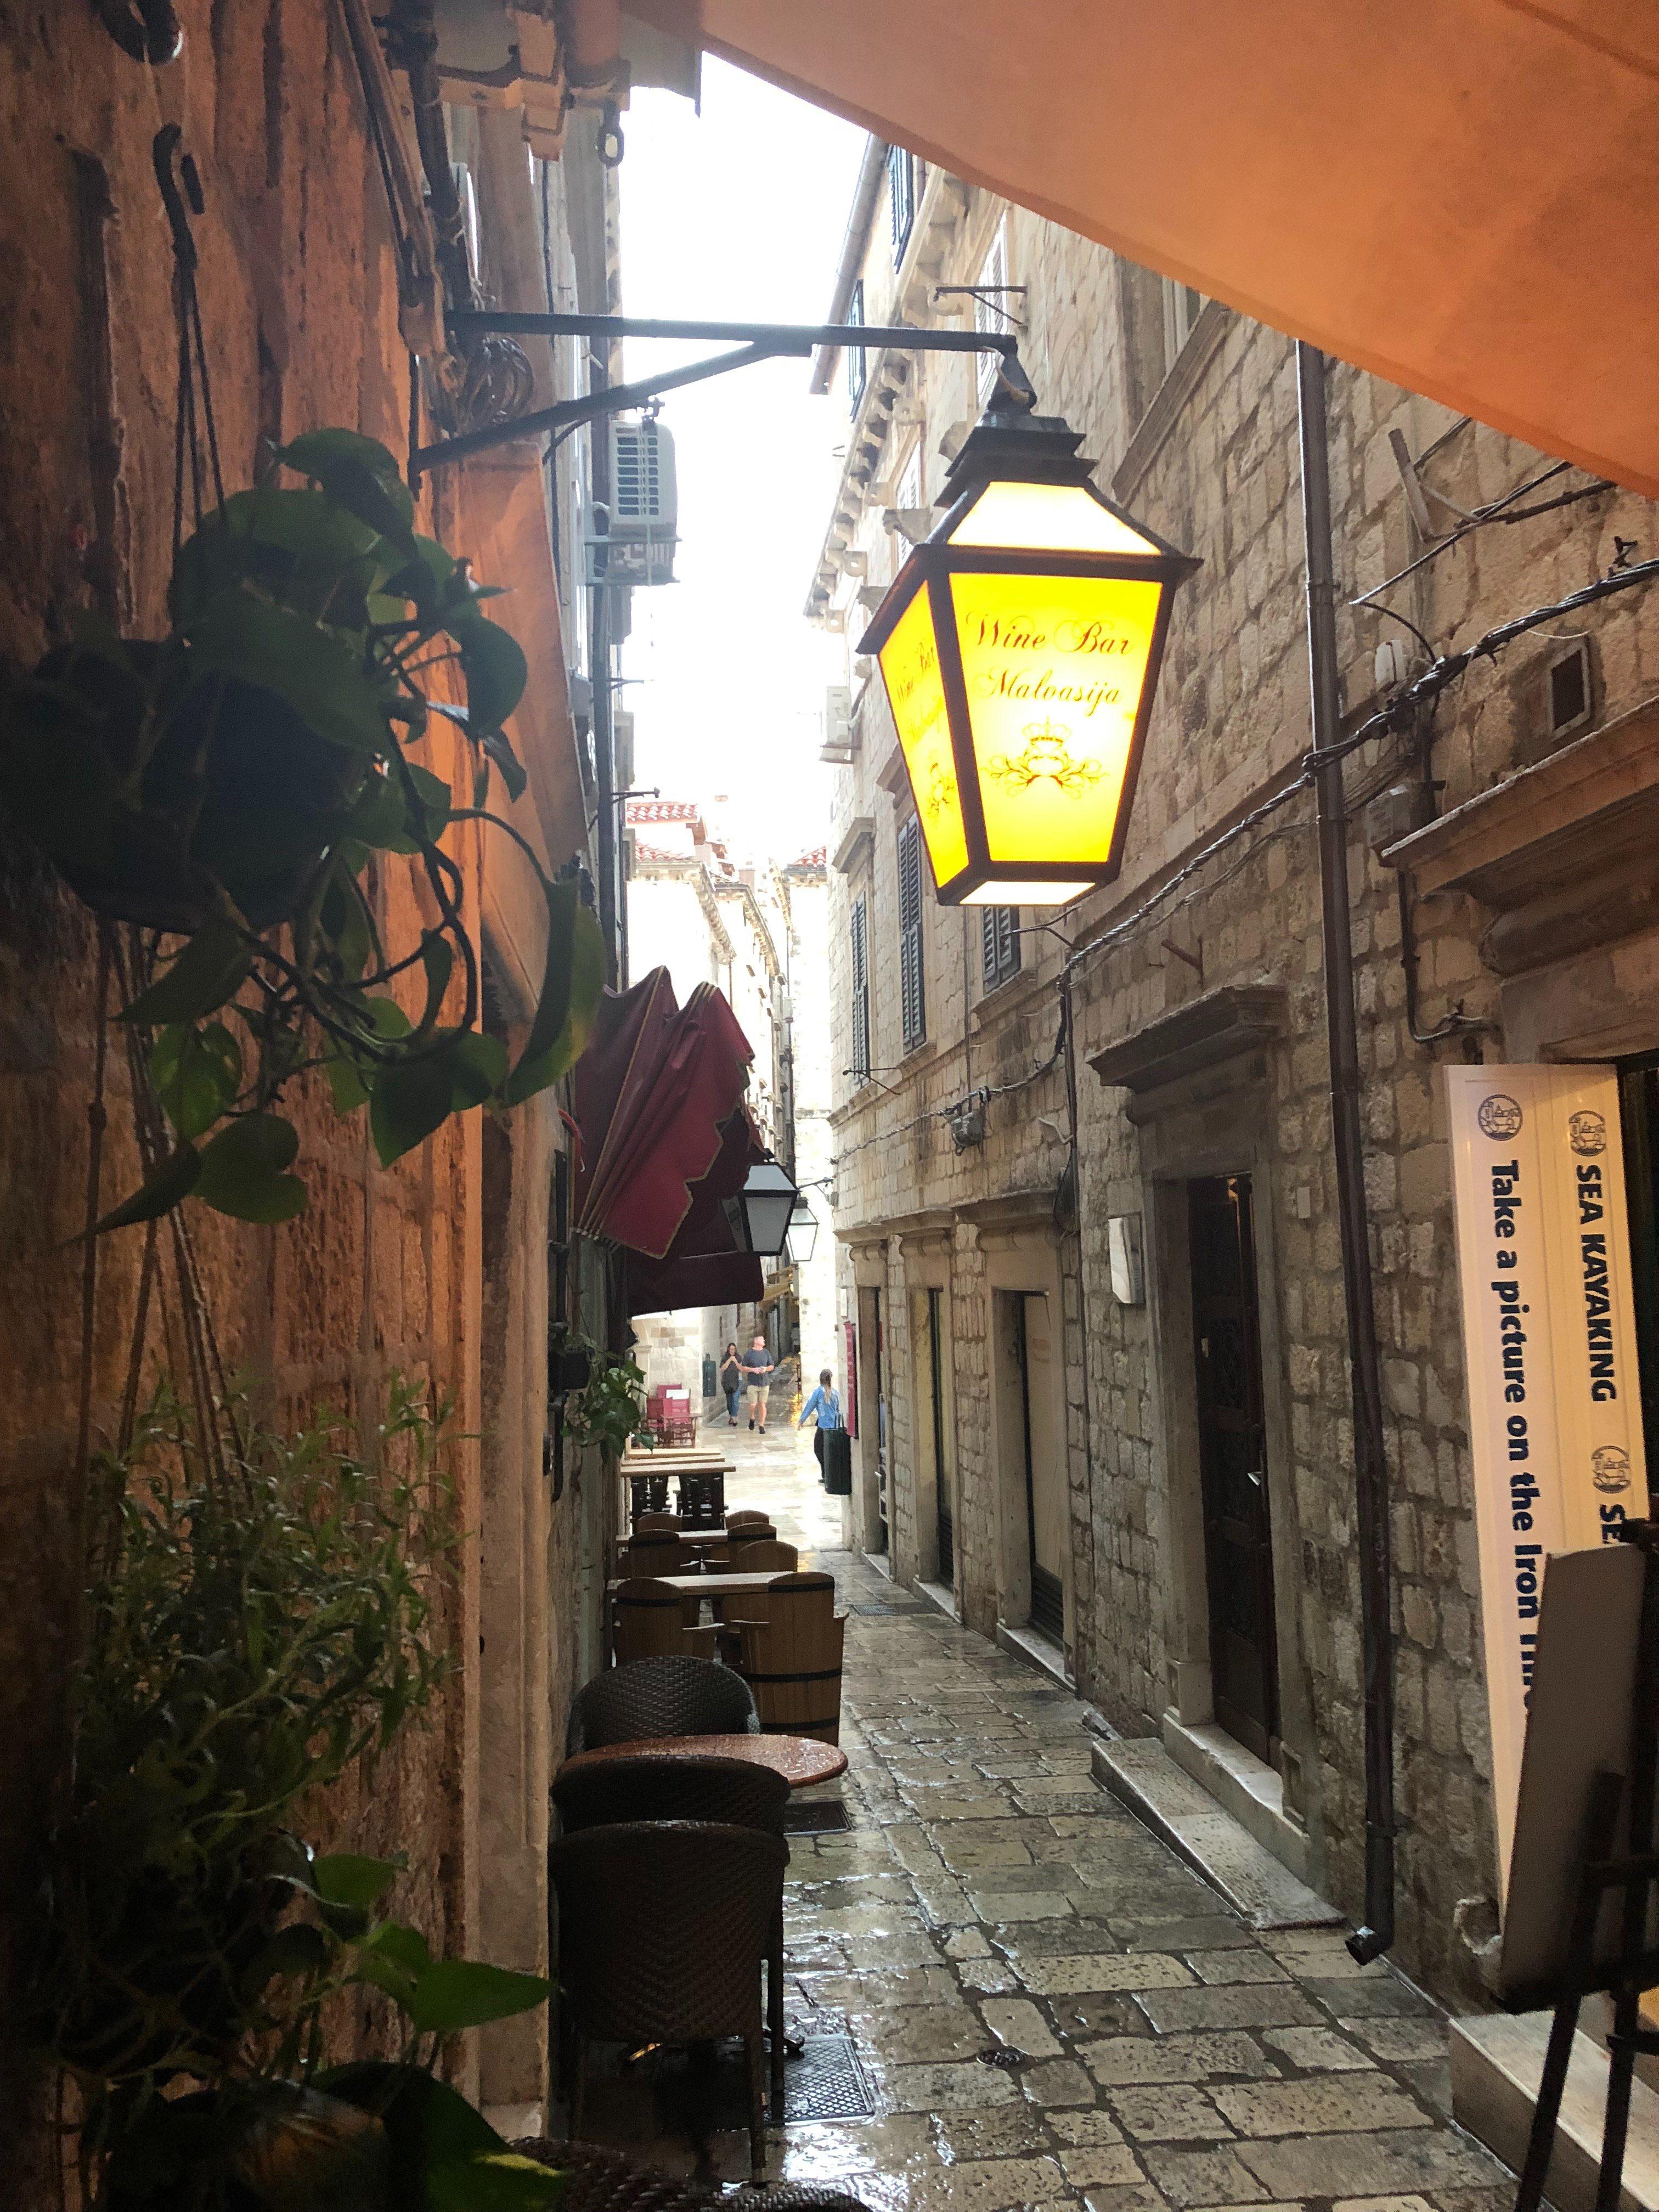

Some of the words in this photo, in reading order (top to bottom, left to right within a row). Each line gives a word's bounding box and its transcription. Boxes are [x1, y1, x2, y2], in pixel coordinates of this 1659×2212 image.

[966, 610, 1047, 650] Wine
[1054, 618, 1135, 654] Bar
[1491, 1160, 1522, 1238] Take
[1576, 1164, 1604, 1225] SEA
[1497, 1249, 1517, 1268] a
[1491, 1280, 1530, 1403] picture
[1581, 1233, 1617, 1402] KAYAKING
[1507, 1415, 1528, 1461] on
[1510, 1472, 1541, 1531] the
[1599, 1504, 1625, 1544] SE
[1515, 1544, 1542, 1619] Iron
